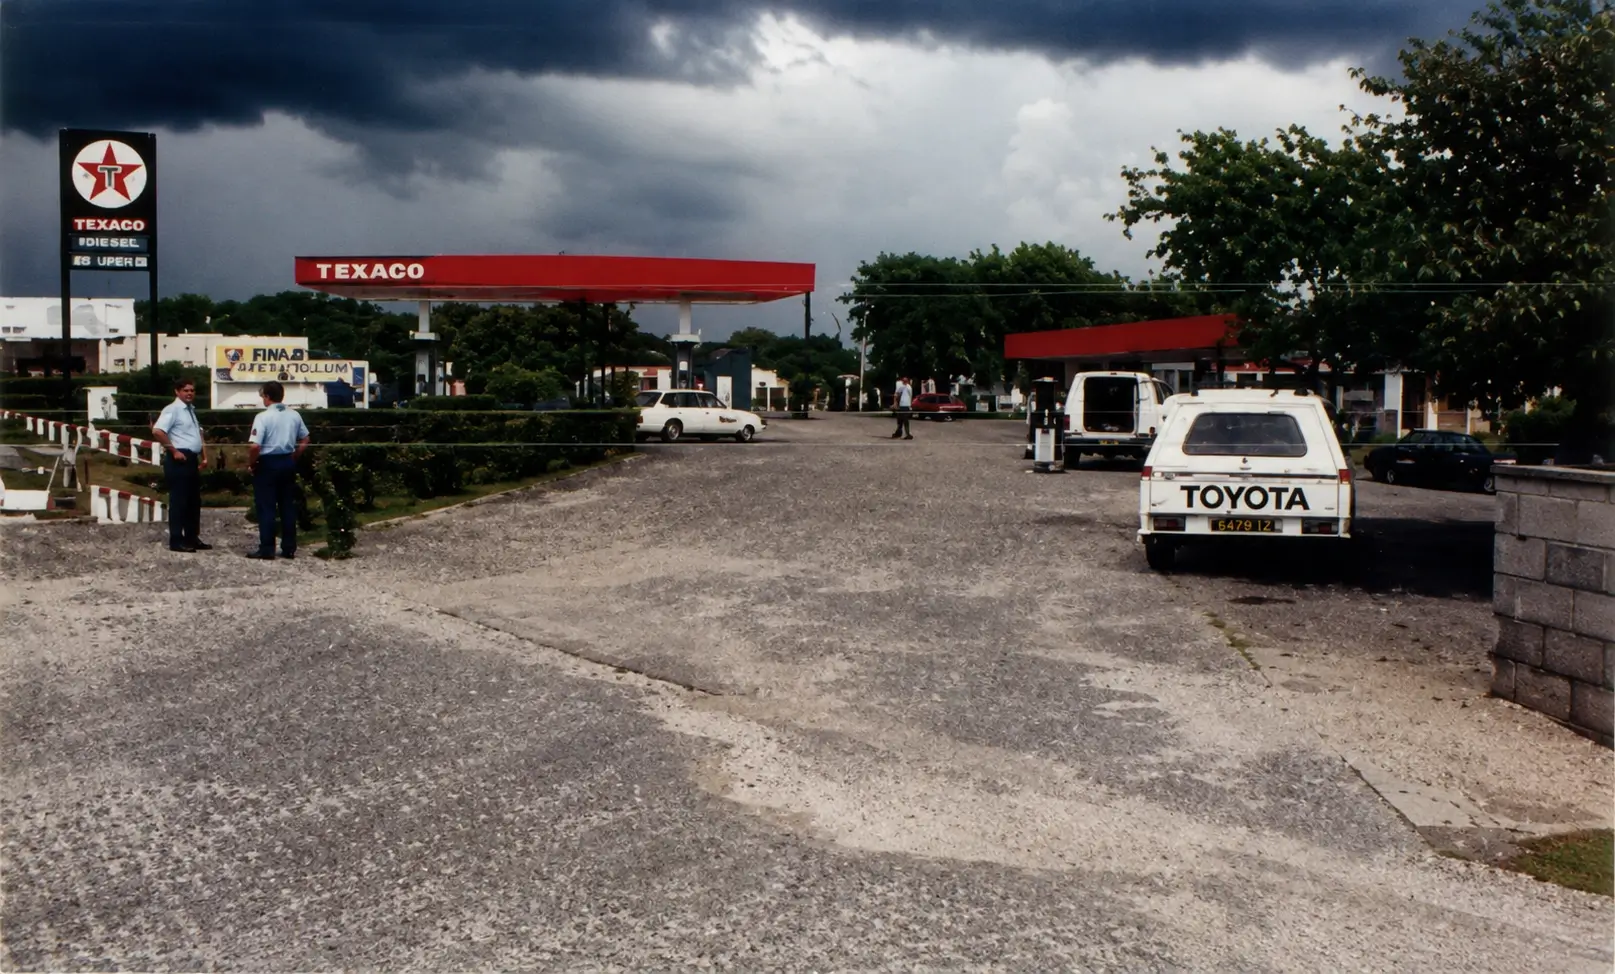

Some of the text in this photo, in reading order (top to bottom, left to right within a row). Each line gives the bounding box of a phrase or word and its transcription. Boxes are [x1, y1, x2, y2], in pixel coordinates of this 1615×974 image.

[74, 219, 145, 231] TEXACO
[316, 263, 425, 279] TEXACO
[1180, 485, 1310, 510] TOYOTA
[1218, 520, 1252, 531] 6479
